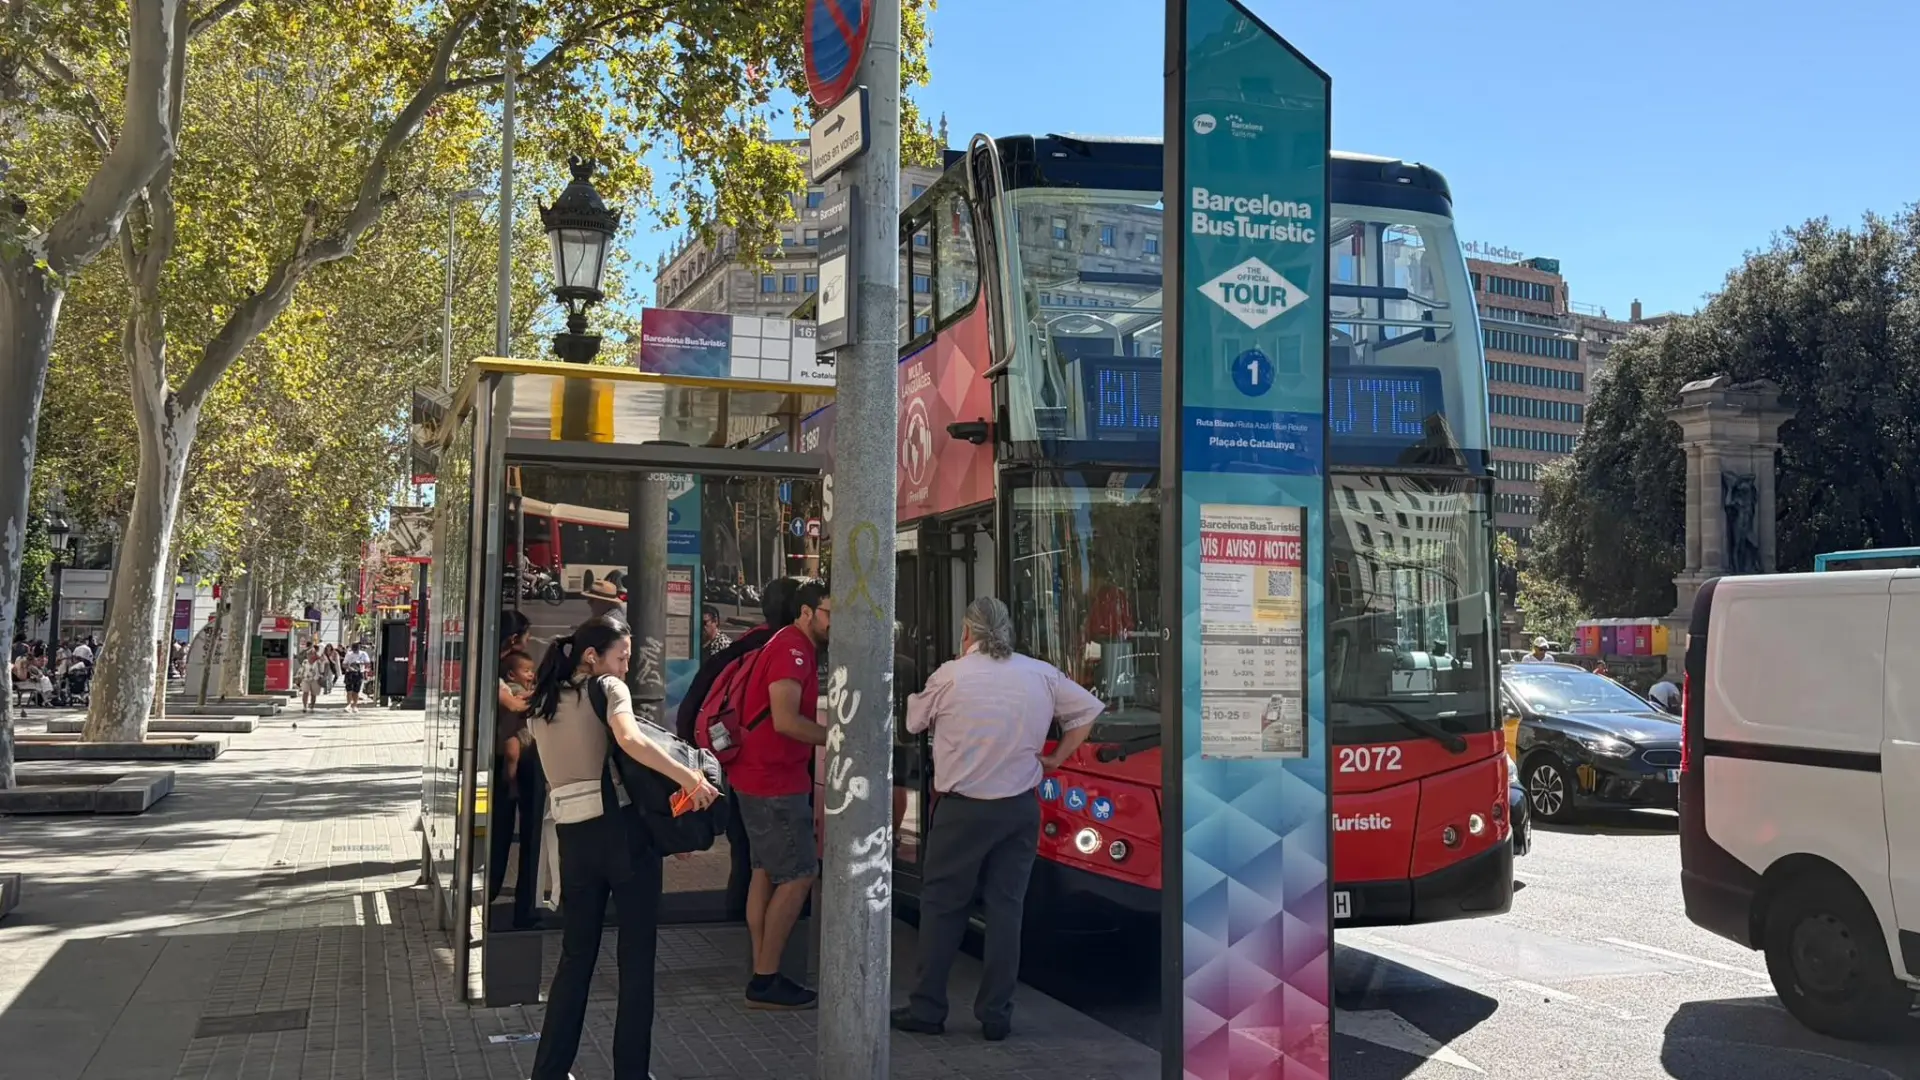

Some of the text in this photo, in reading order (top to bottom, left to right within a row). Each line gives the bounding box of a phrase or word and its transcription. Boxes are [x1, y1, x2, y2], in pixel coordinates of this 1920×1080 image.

[1231, 120, 1264, 132] Barcelona
[814, 130, 860, 171] Motos en vorera
[1192, 187, 1312, 219] Barcelona
[1191, 211, 1316, 244] BusTurístic
[1484, 241, 1524, 260] Locker
[1236, 273, 1270, 283] OFFICIAL
[1247, 266, 1262, 275] THE
[1218, 282, 1287, 308] TOUR
[643, 334, 684, 345] Barcelona
[907, 361, 924, 379] MULTI
[1246, 360, 1259, 385] 1
[901, 371, 932, 399] LANGUAGES
[1196, 419, 1213, 427] Ruta
[1288, 423, 1308, 432] Route
[1209, 437, 1295, 451] Plaça de Catalunya
[1200, 519, 1248, 531] Barcelona
[1226, 538, 1256, 558] AVISO
[1264, 540, 1301, 560] NOTICE
[1404, 672, 1415, 689] 7
[1213, 710, 1240, 720] 10-25
[1339, 746, 1402, 773] 2072
